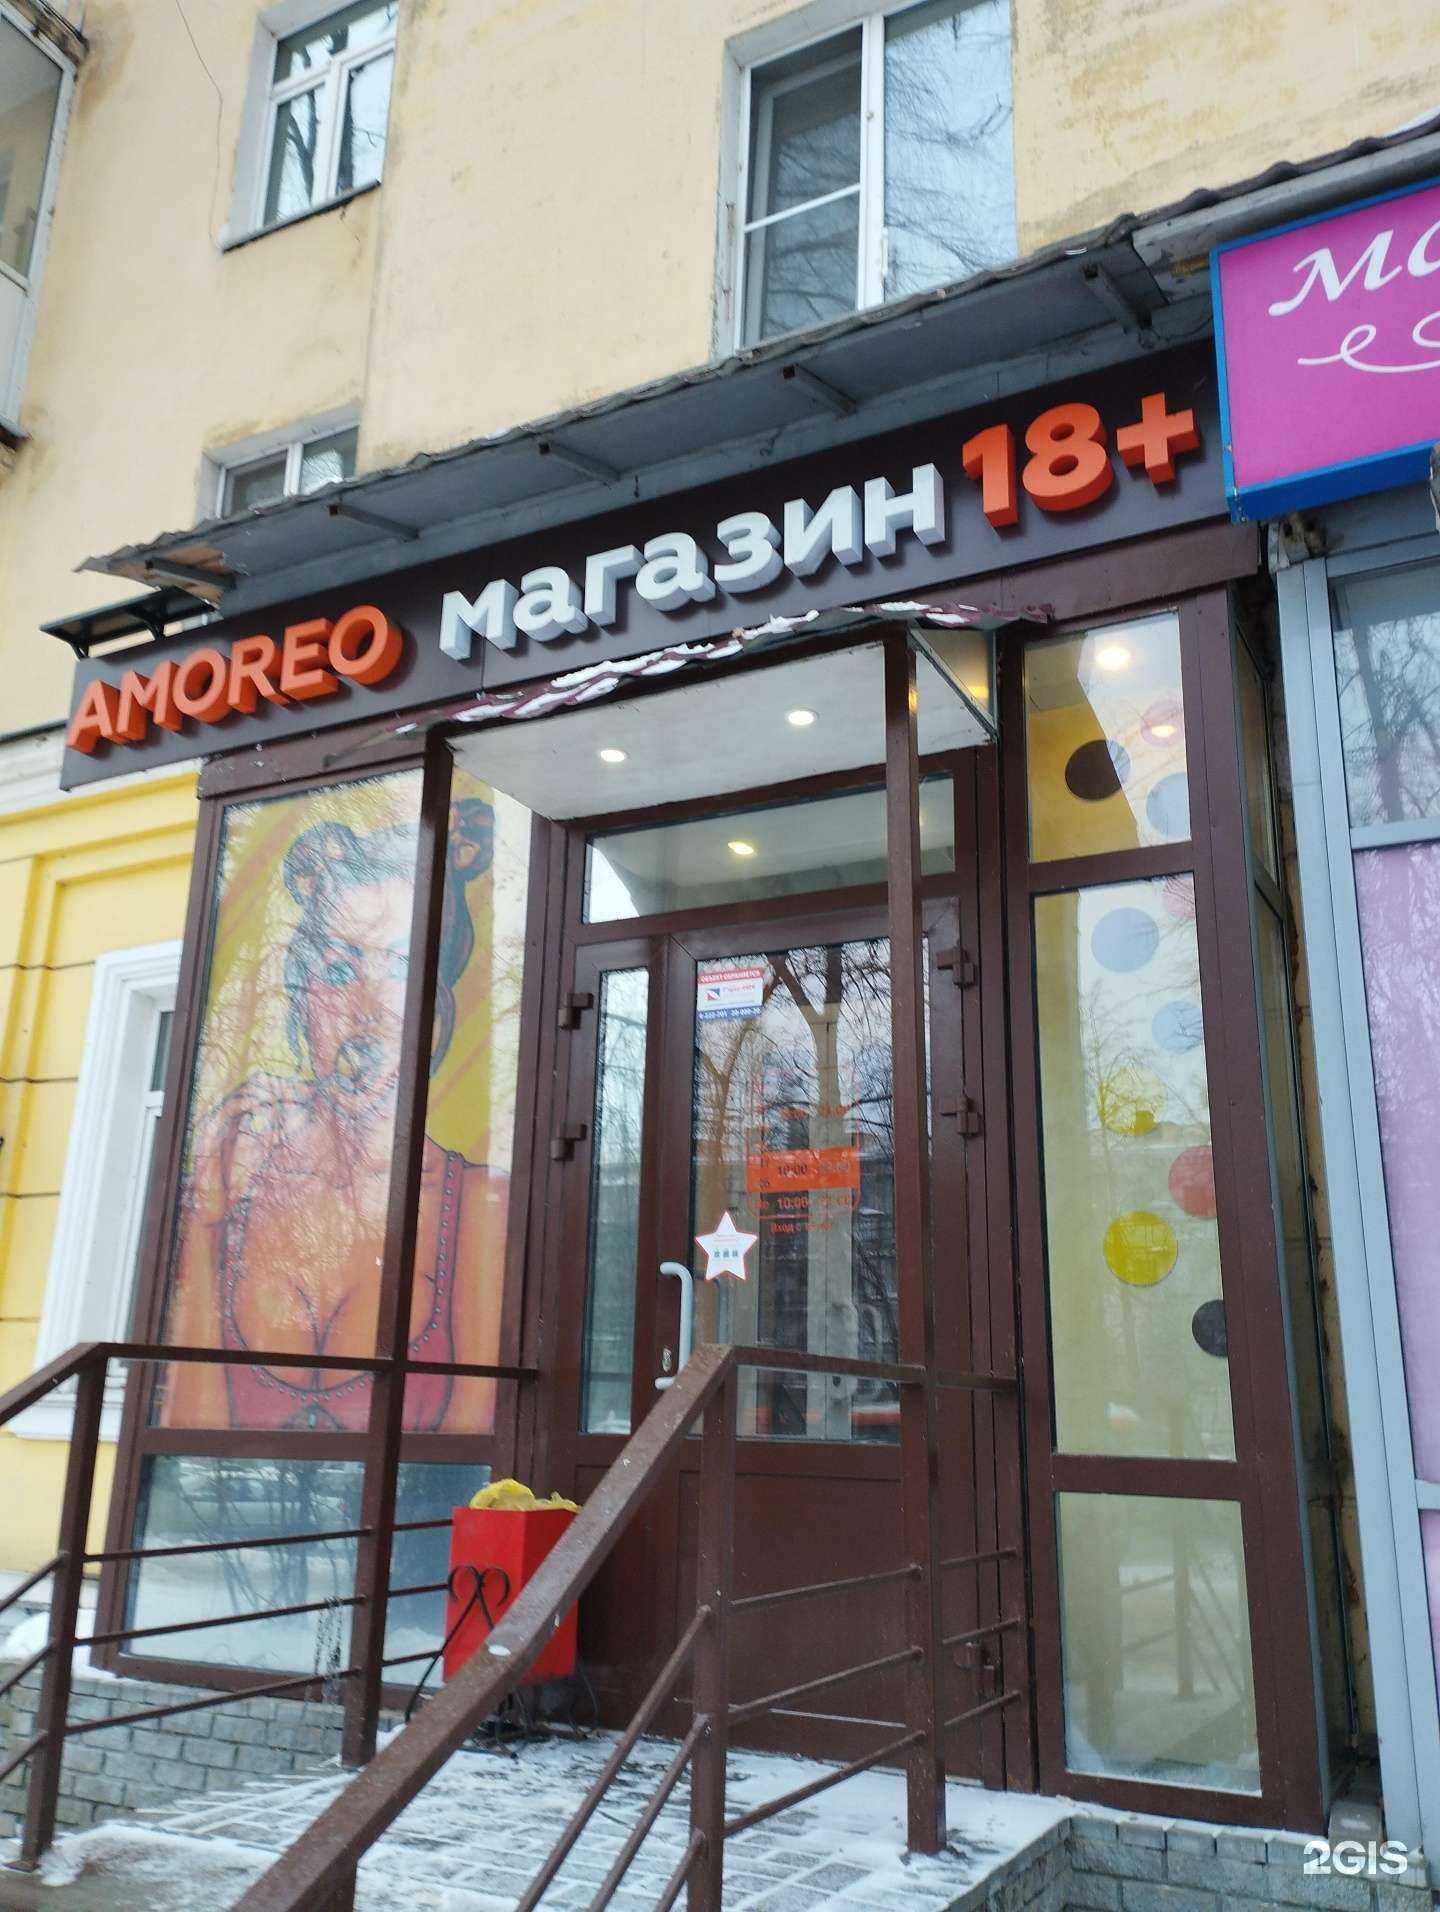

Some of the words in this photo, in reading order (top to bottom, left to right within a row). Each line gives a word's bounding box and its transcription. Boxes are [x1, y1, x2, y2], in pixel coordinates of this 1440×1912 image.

[66, 604, 404, 754] AMOREO
[439, 462, 945, 660] магазин
[962, 391, 1200, 527] 18+
